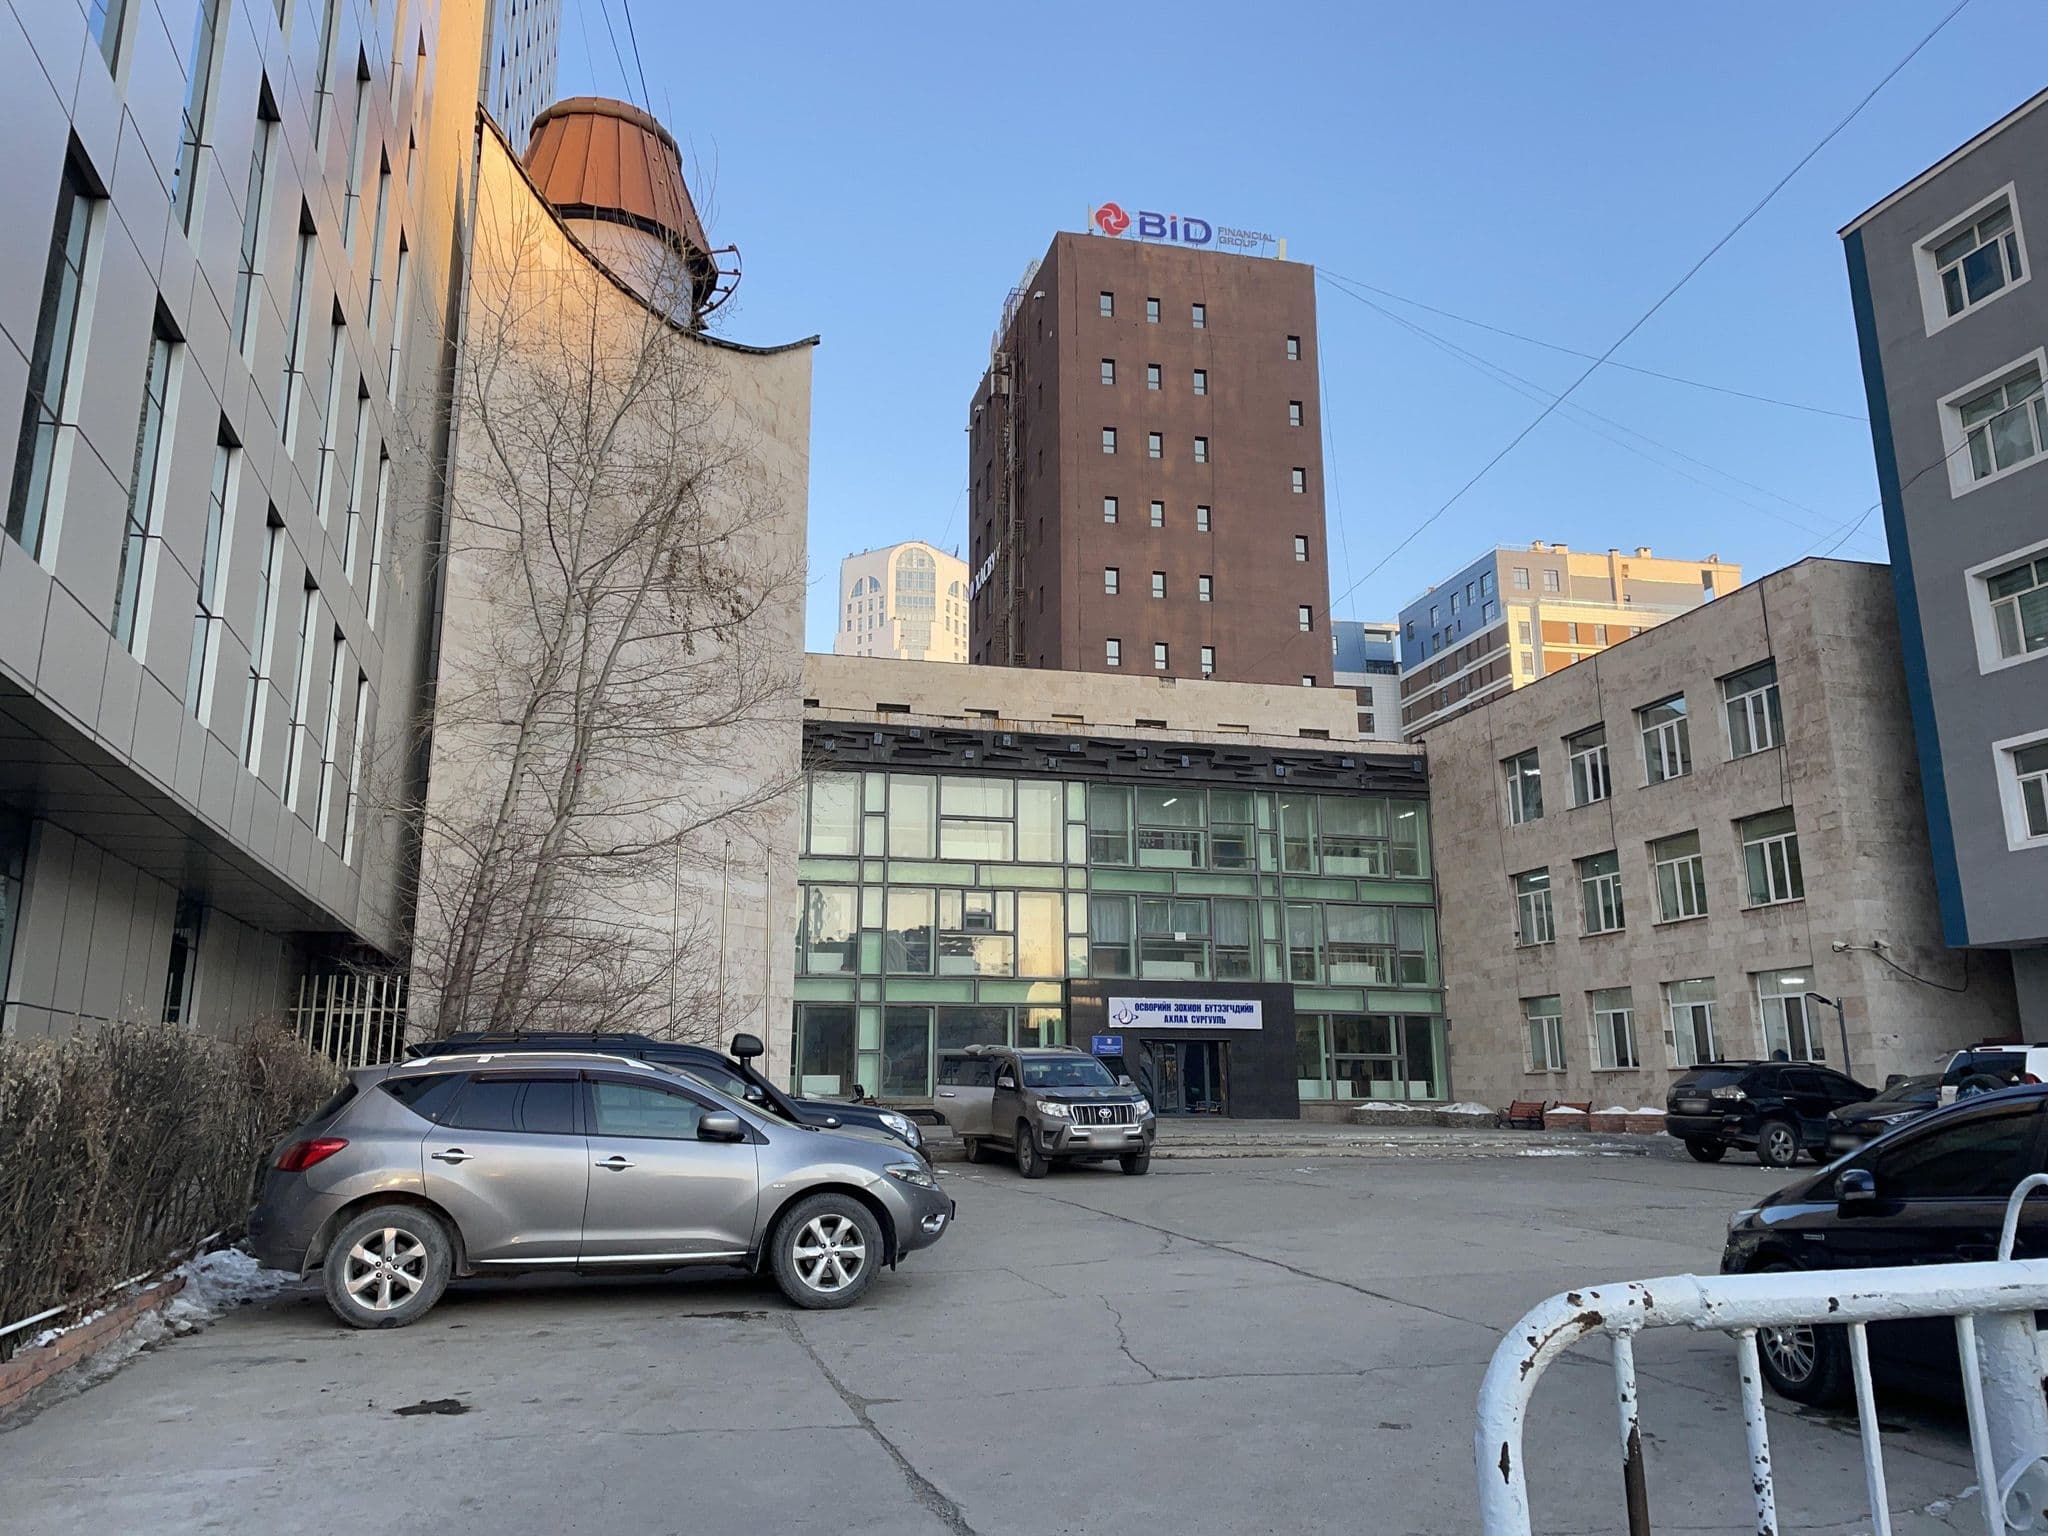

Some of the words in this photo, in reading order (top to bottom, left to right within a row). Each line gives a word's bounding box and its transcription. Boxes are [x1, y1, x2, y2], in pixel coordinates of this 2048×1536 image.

[1218, 226, 1276, 242] FINANCIAL
[1219, 237, 1258, 248] GROUP
[1174, 1003, 1202, 1012] ЗОХИОН
[1164, 1015, 1189, 1023] АХЛАХ
